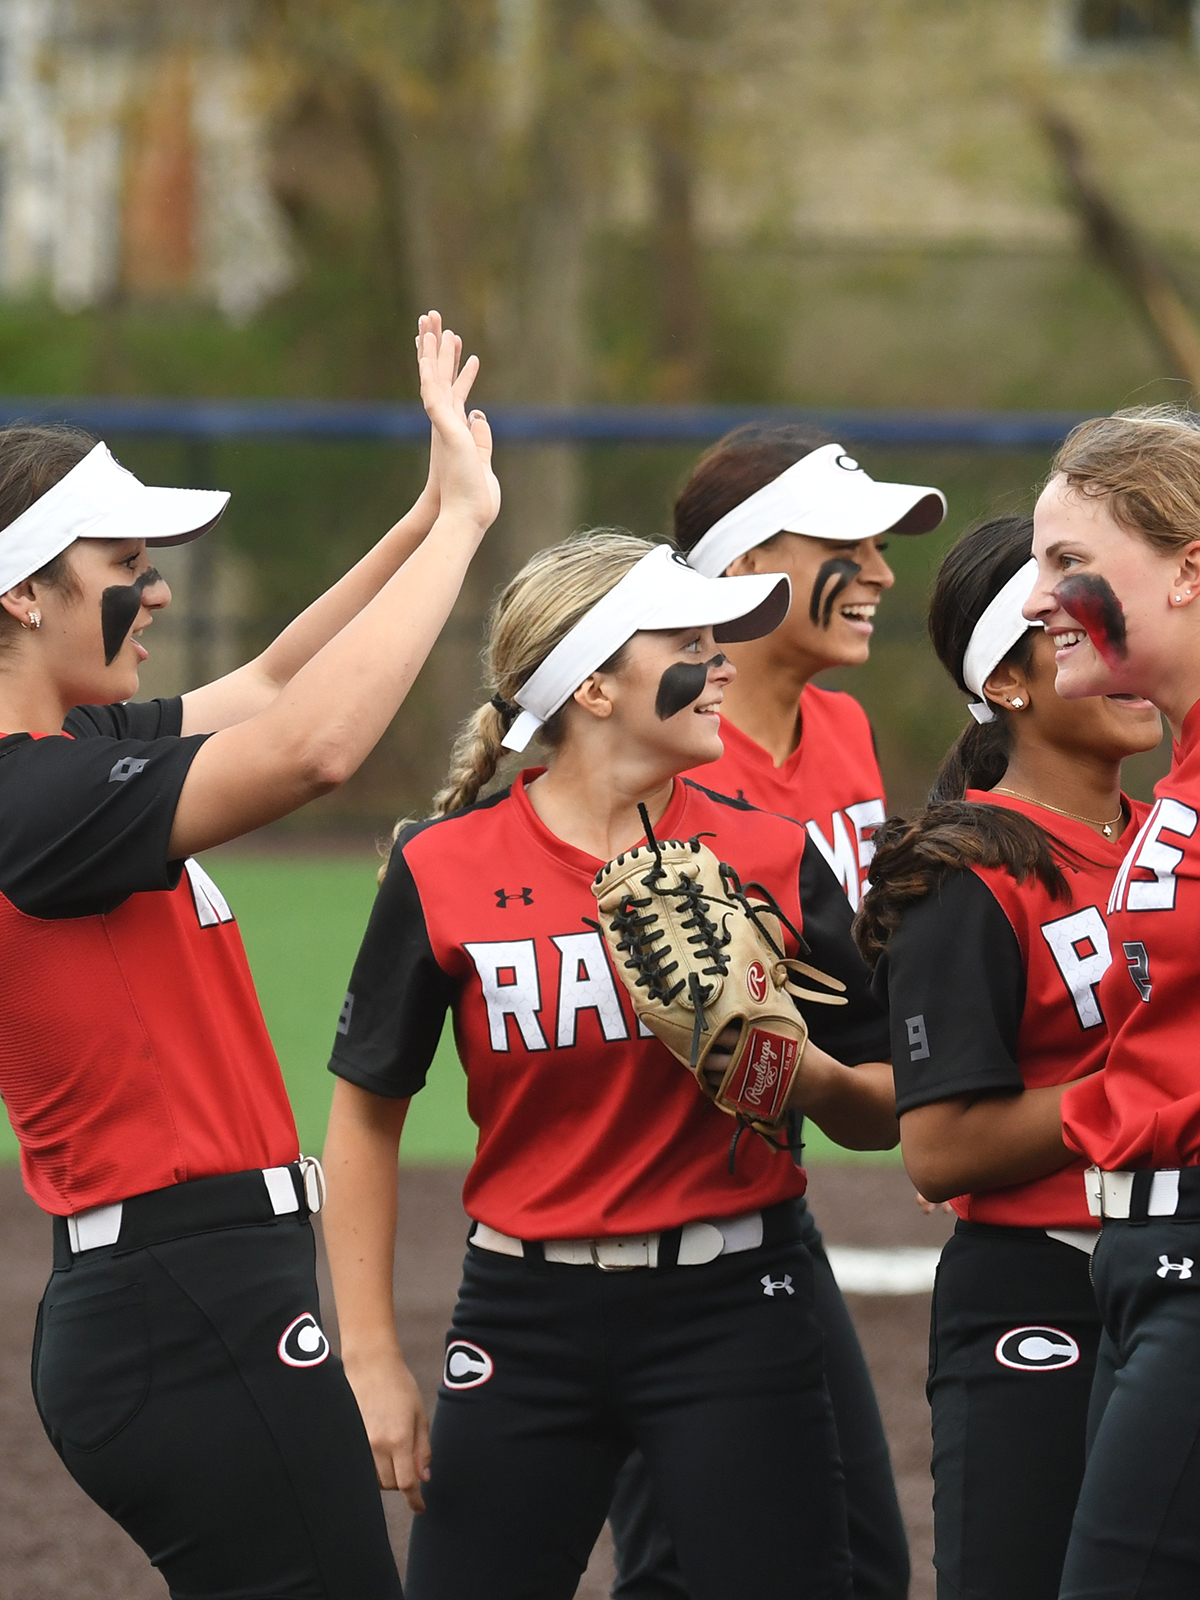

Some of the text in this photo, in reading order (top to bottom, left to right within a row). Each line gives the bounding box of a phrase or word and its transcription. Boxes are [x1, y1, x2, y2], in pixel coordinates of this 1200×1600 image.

[460, 930, 658, 1052] RA
[905, 1014, 931, 1062] 9
[744, 1039, 778, 1106] Rawlings
[281, 1314, 328, 1364] C
[999, 1328, 1076, 1368] C
[445, 1343, 490, 1387] C
